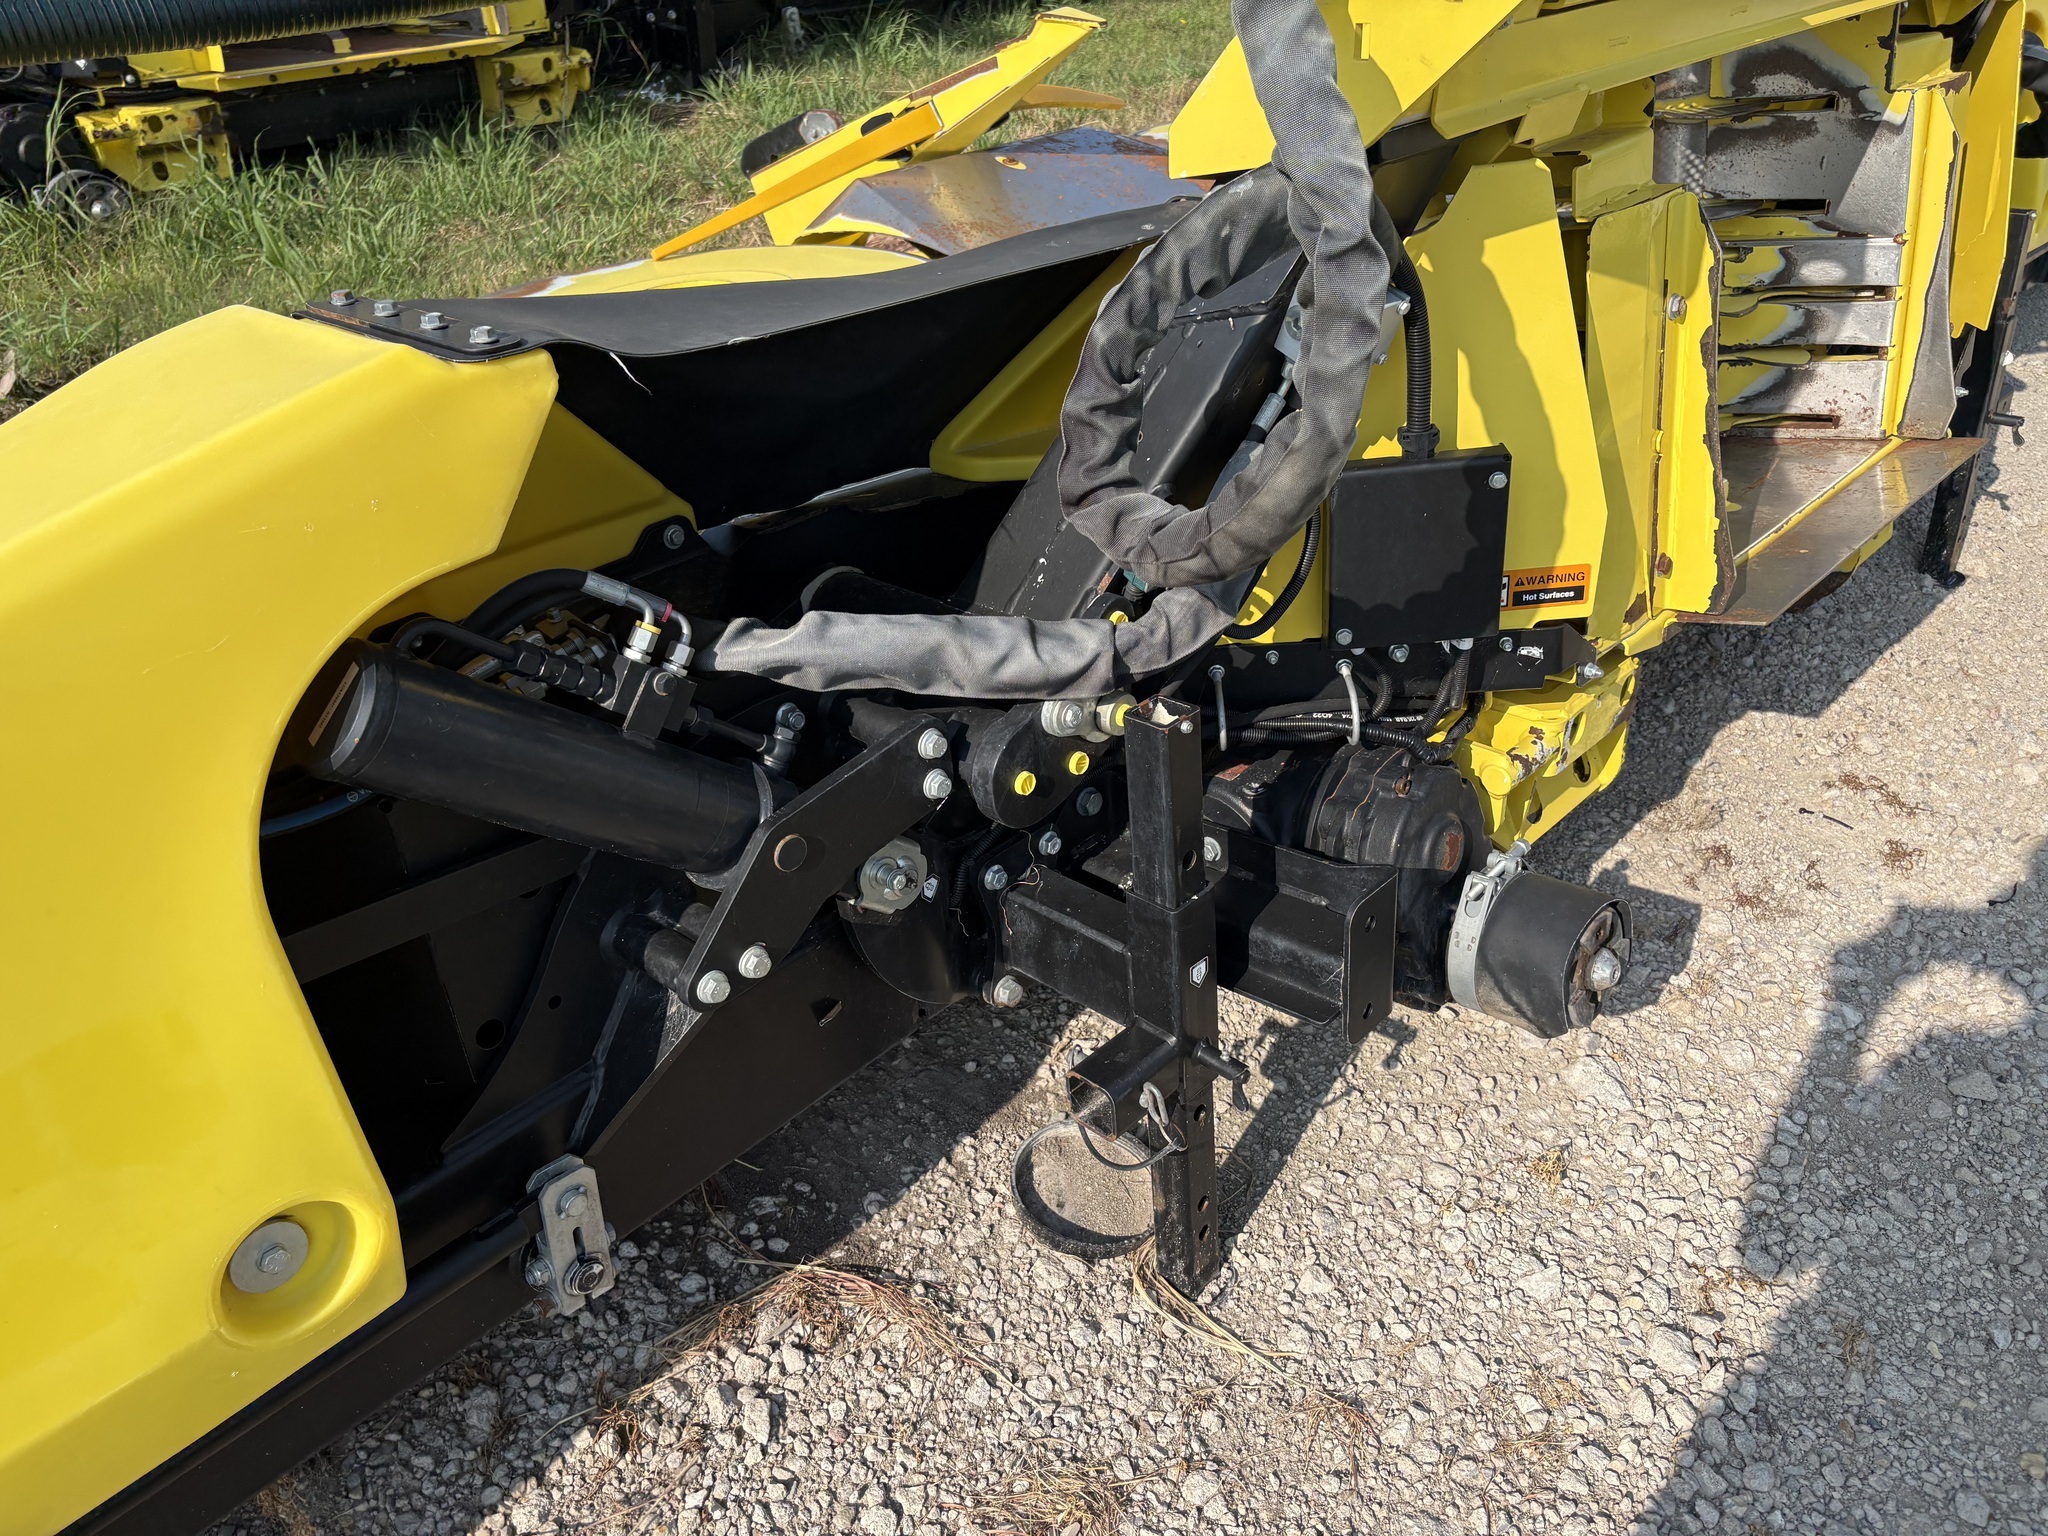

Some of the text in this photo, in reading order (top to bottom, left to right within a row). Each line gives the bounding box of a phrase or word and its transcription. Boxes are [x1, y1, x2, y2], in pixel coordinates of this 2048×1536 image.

[1526, 572, 1585, 586] WARNING
[1522, 591, 1574, 601] Hot Surfaces
